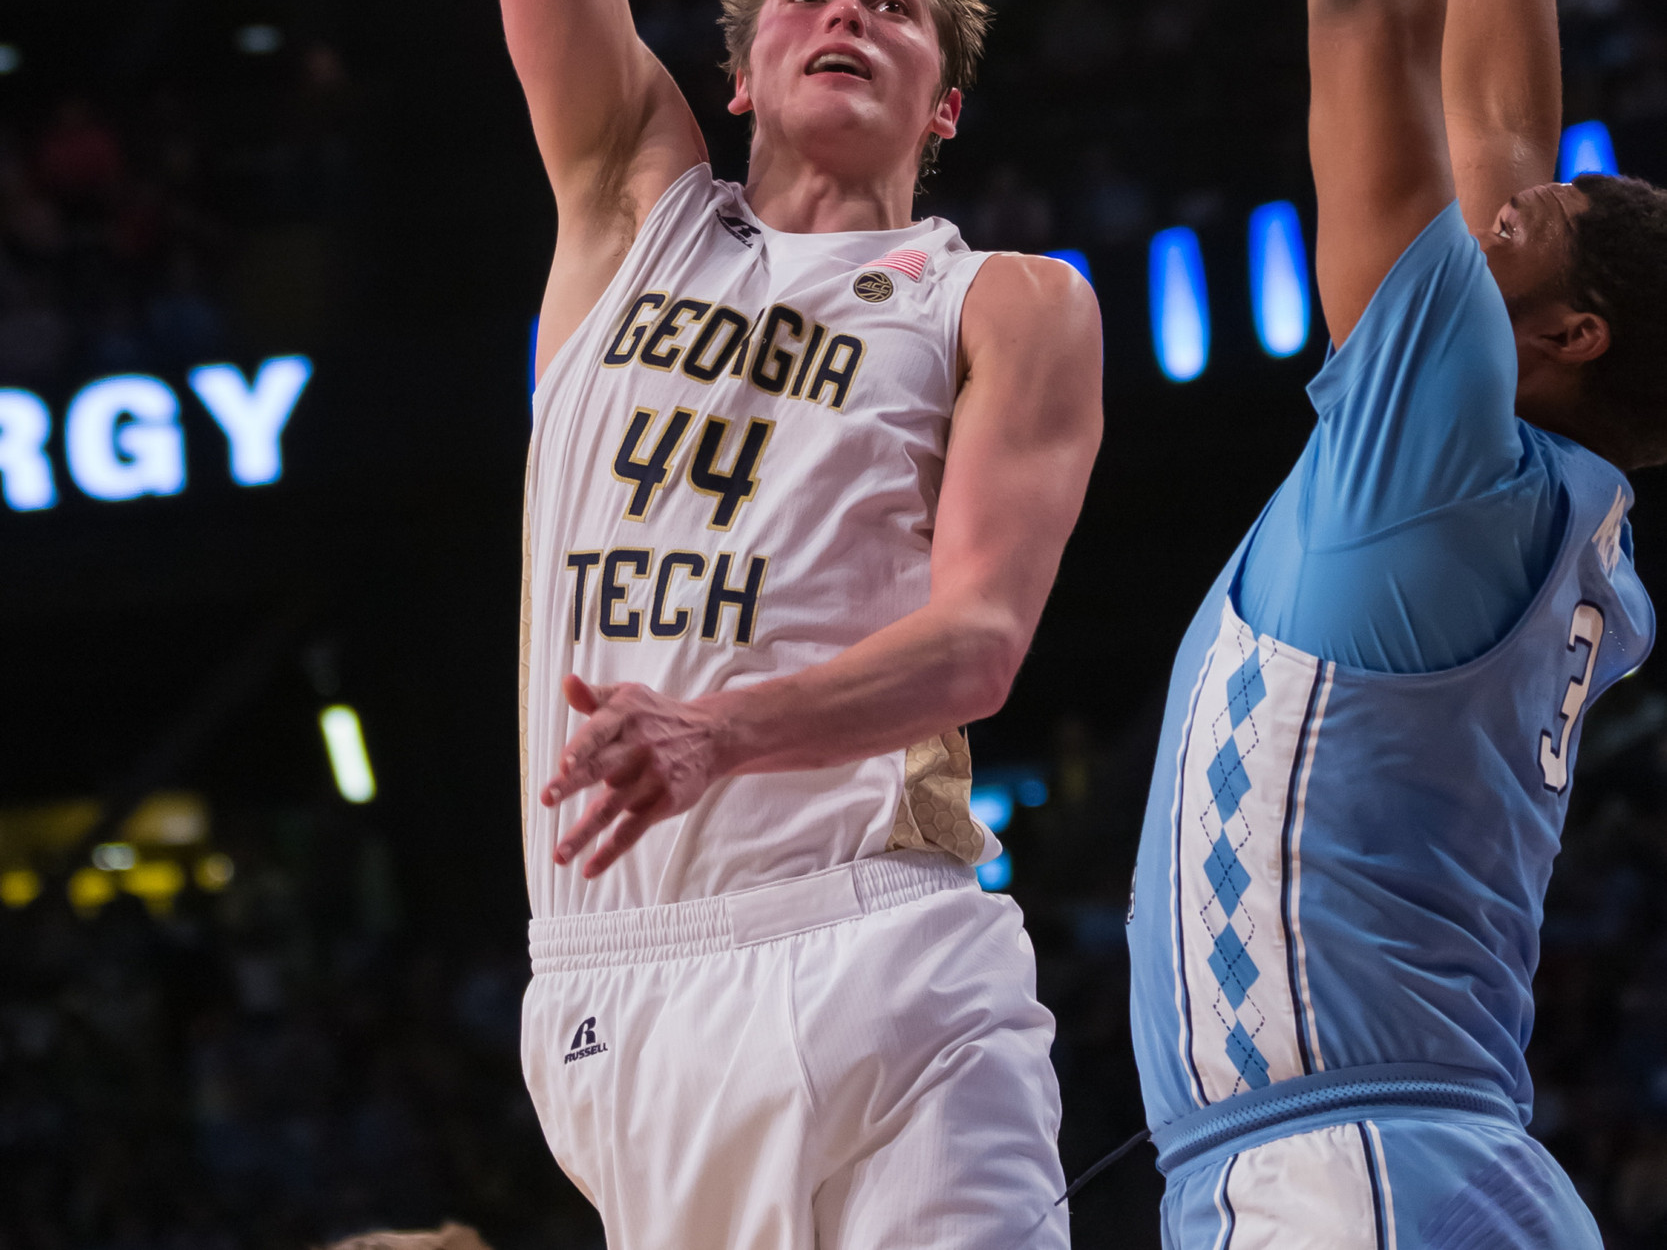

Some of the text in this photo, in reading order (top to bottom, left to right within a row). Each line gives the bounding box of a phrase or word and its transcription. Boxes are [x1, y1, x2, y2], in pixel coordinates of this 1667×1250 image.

[858, 281, 890, 293] ACC
[612, 406, 776, 531] 44
[566, 548, 769, 644] TECH
[1539, 599, 1604, 795] 3
[564, 1042, 608, 1064] RUSSELL
